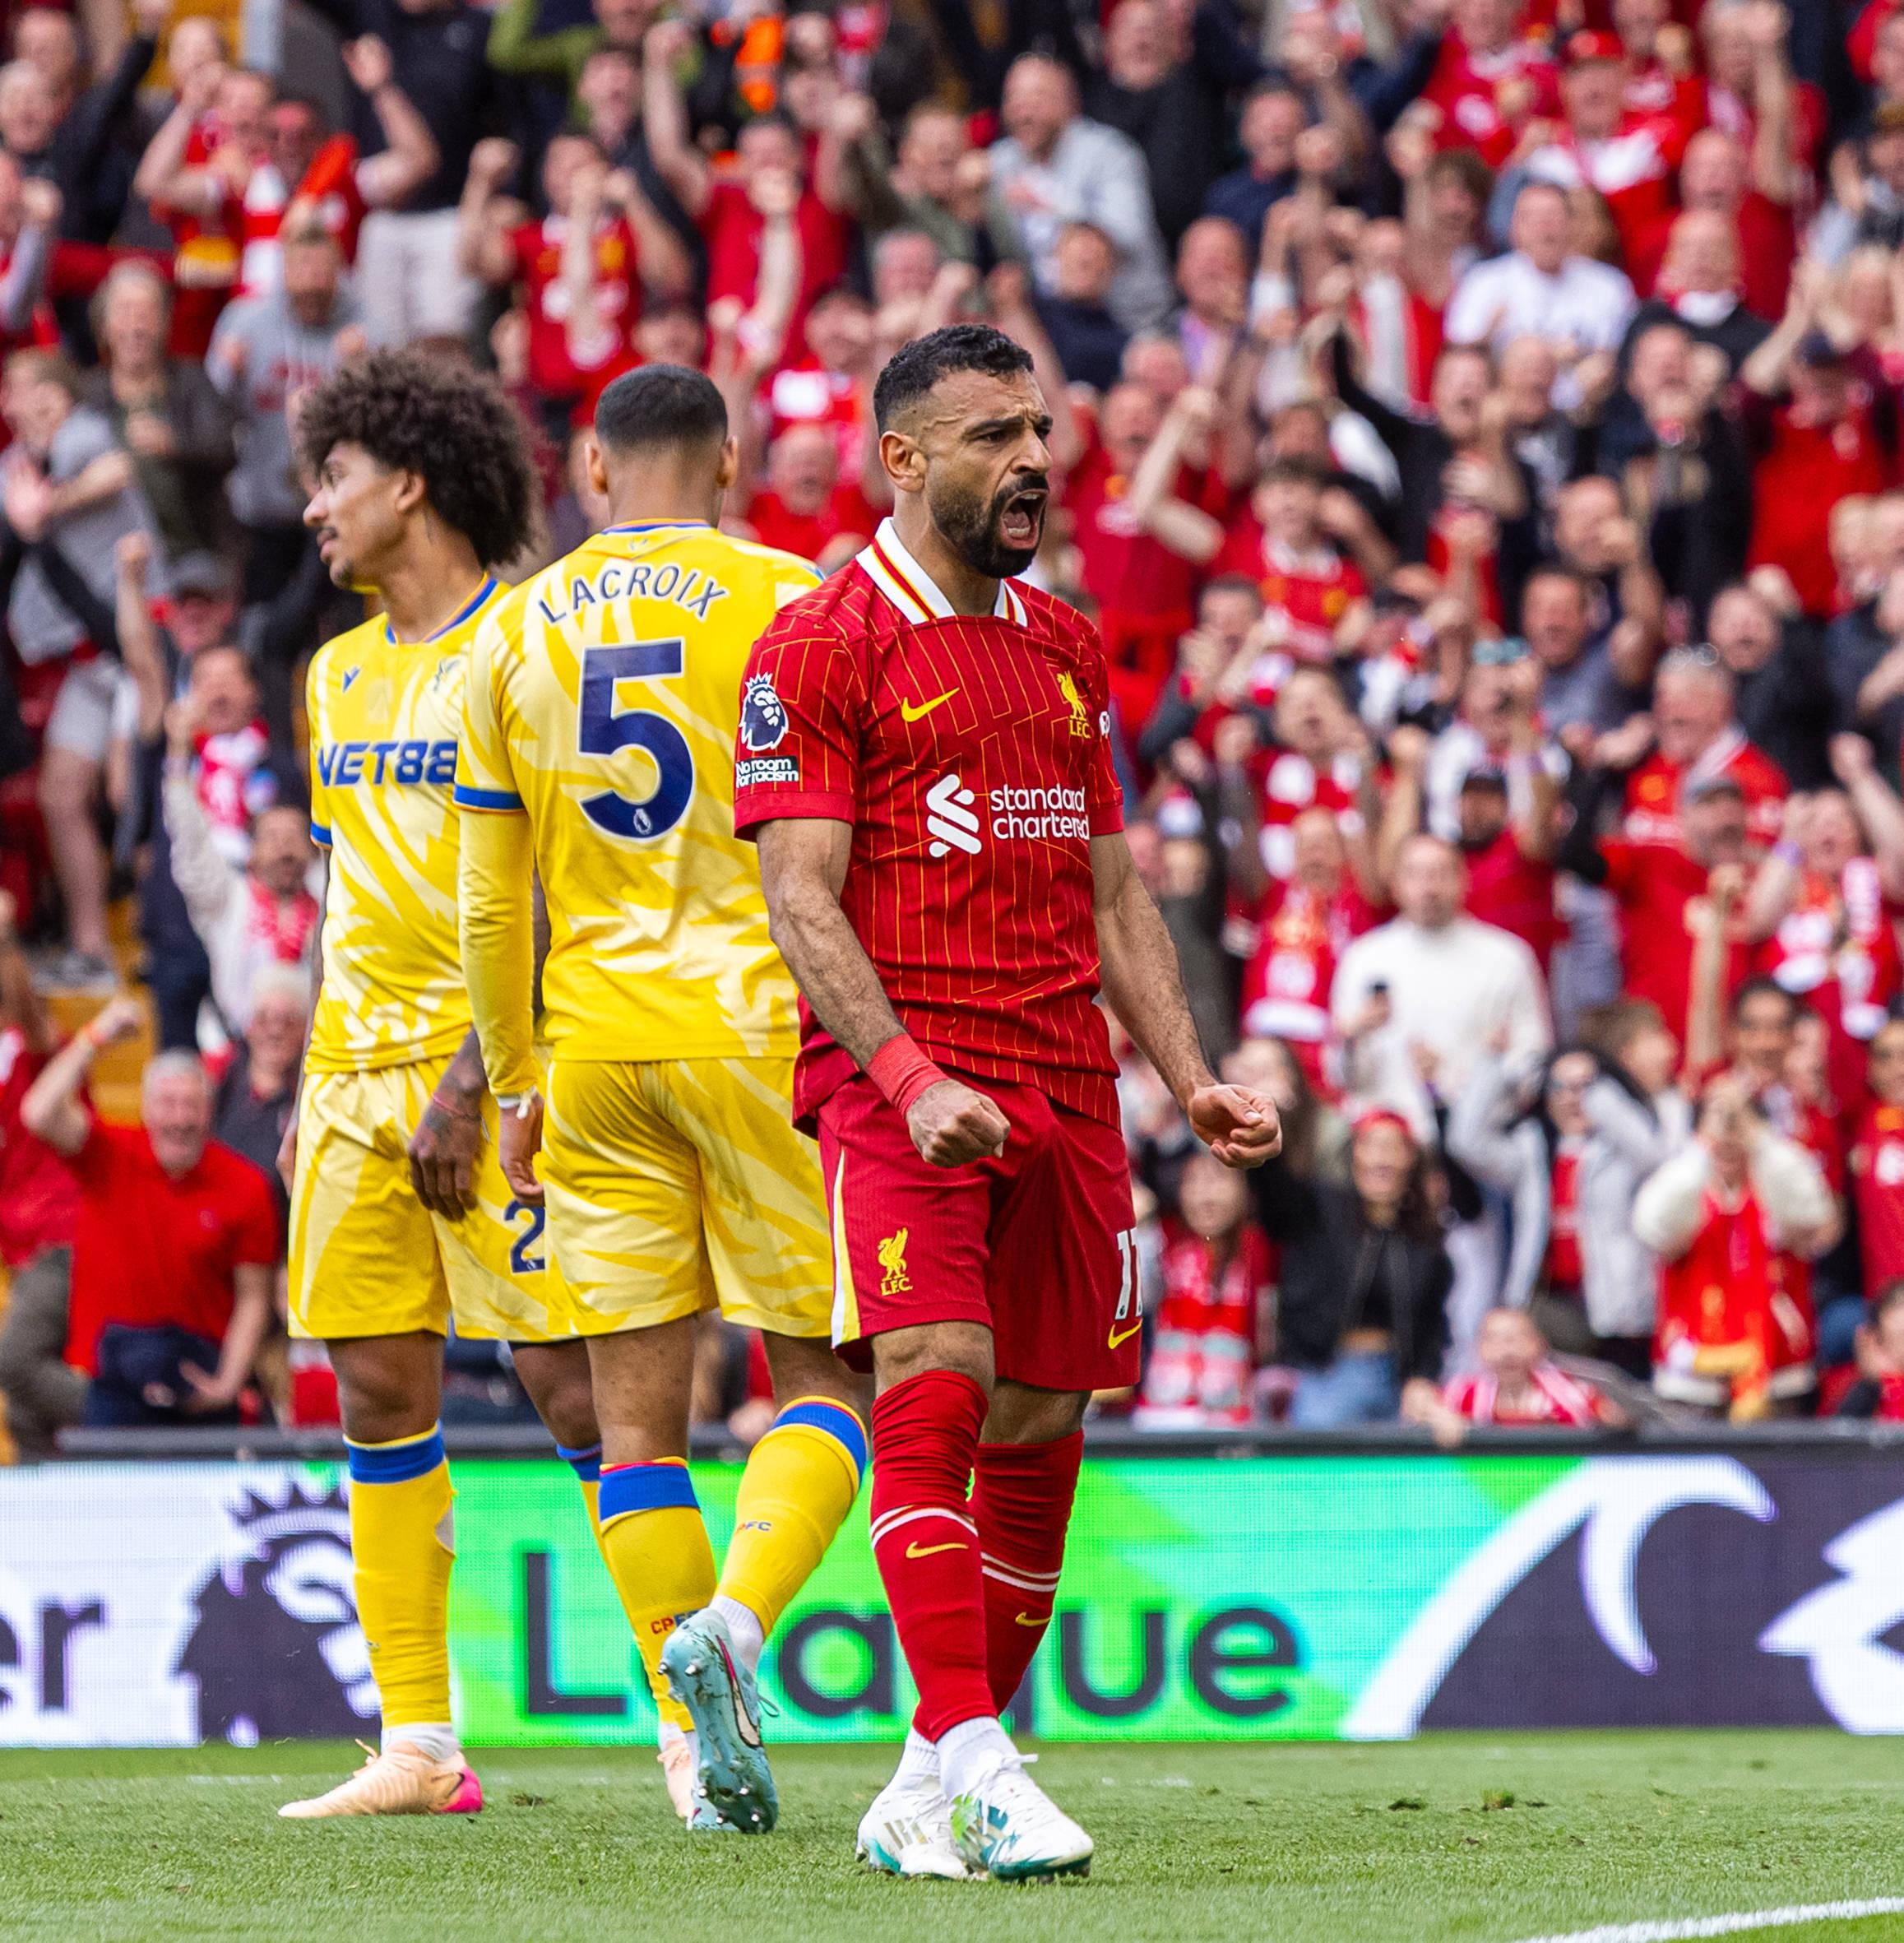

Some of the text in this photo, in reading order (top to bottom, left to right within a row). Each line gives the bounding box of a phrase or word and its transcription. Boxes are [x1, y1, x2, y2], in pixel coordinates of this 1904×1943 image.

[538, 565, 725, 624] LACROIX
[578, 637, 696, 839] 5
[735, 758, 791, 775] No room
[1114, 1227, 1143, 1320] 11
[0, 1551, 1301, 1734] r Laue
